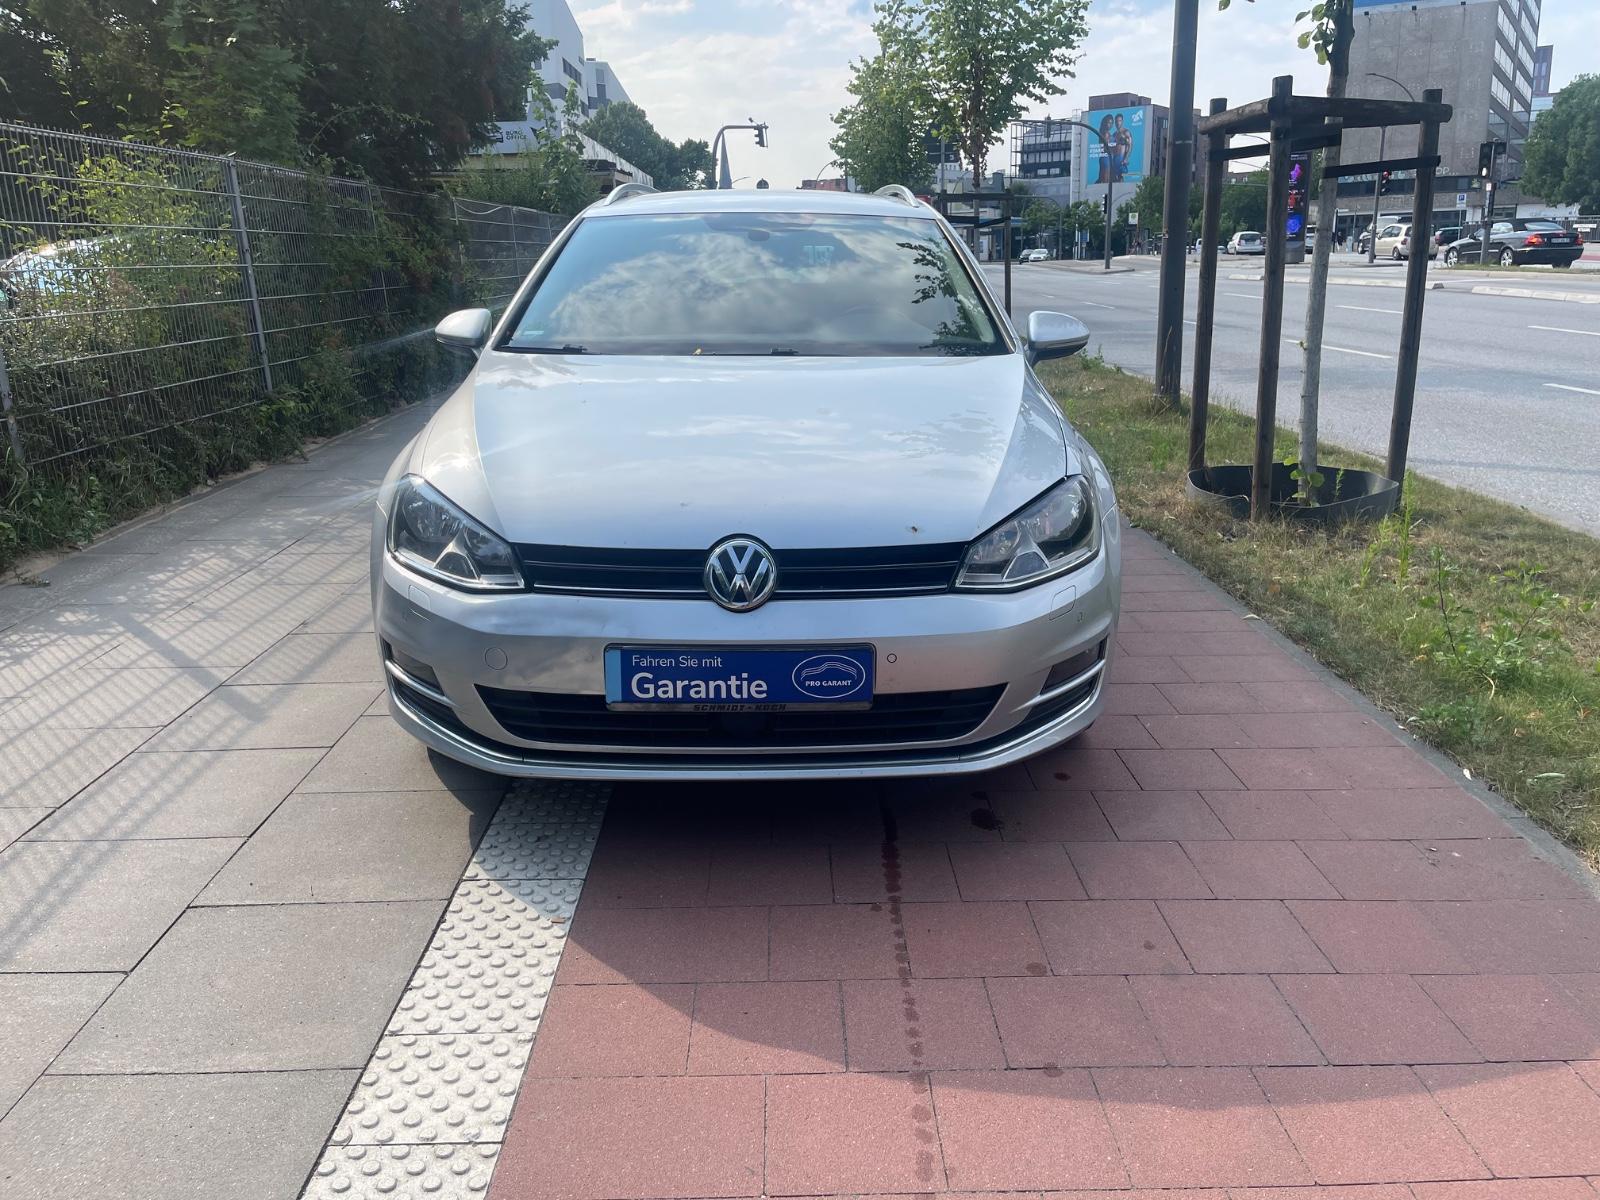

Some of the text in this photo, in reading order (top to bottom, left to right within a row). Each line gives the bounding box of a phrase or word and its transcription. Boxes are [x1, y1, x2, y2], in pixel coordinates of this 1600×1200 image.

[707, 542, 773, 606] VW
[632, 655, 722, 667] Fahren Sie mit
[631, 672, 768, 699] Garantie
[693, 704, 746, 712] SCHMIDT
